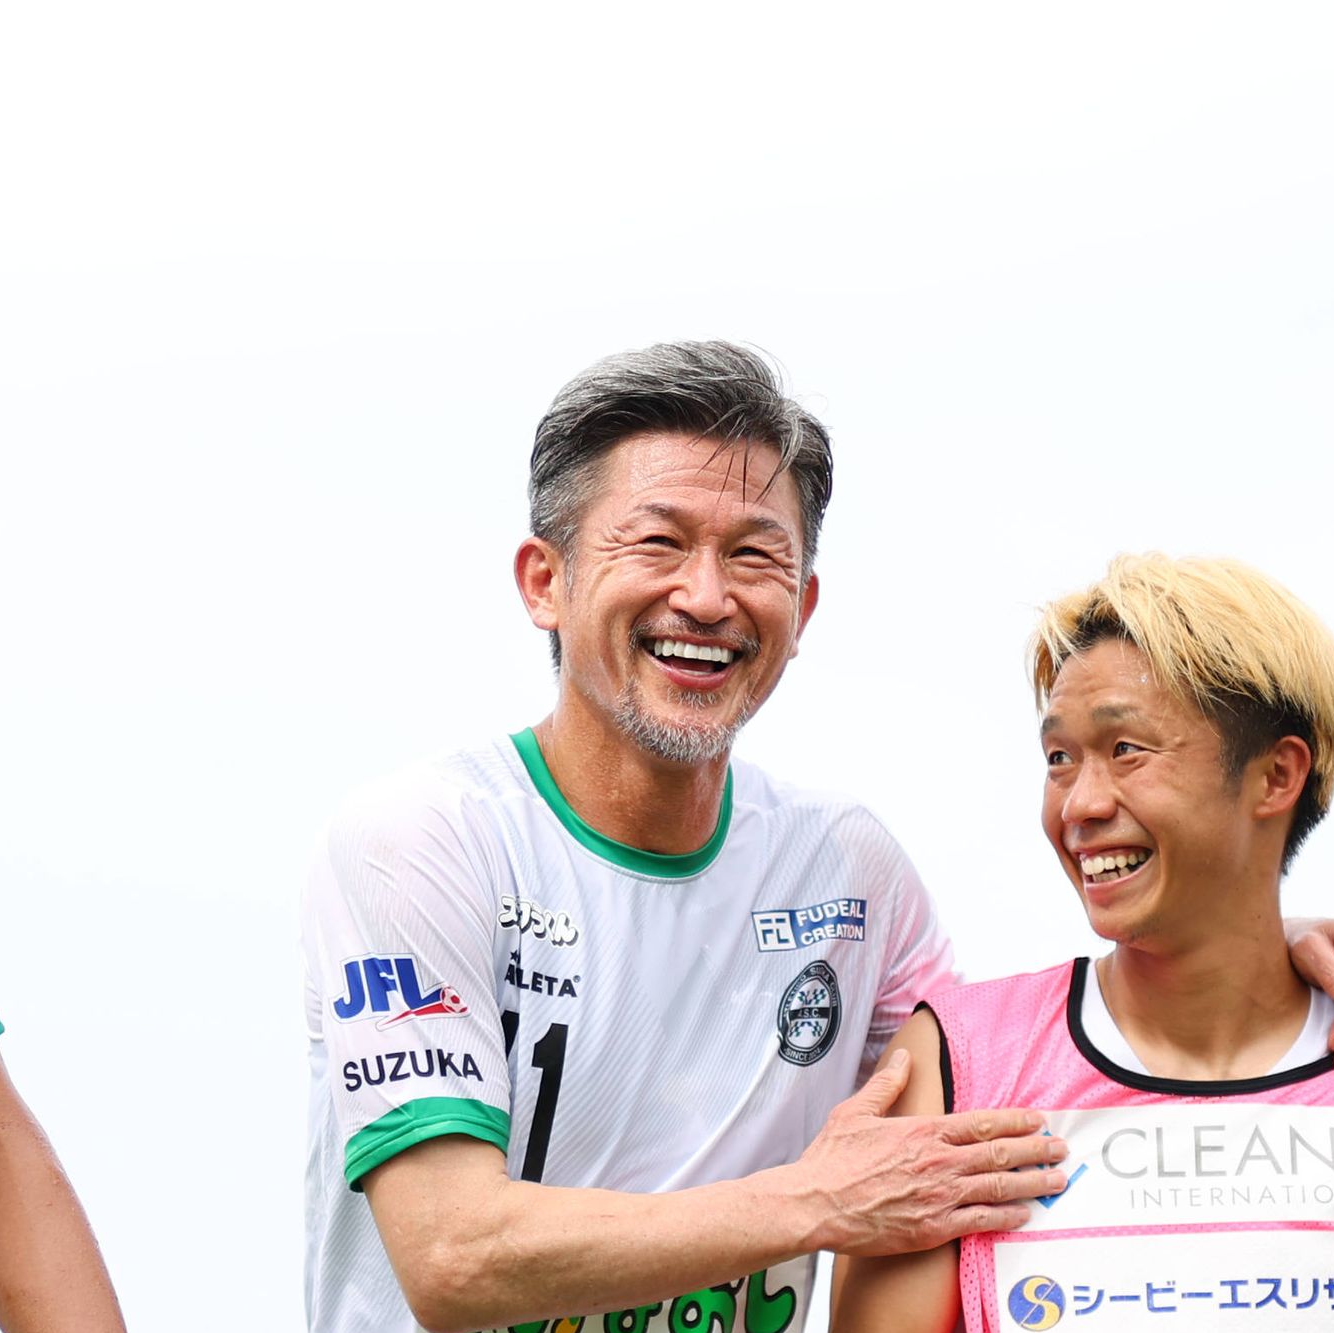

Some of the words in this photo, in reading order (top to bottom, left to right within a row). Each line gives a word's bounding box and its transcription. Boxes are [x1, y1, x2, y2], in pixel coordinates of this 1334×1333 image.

[796, 901, 864, 927] FUDEAL
[801, 923, 864, 945] CREATION
[333, 953, 444, 1022] JFL
[343, 1048, 484, 1092] SUZUKA
